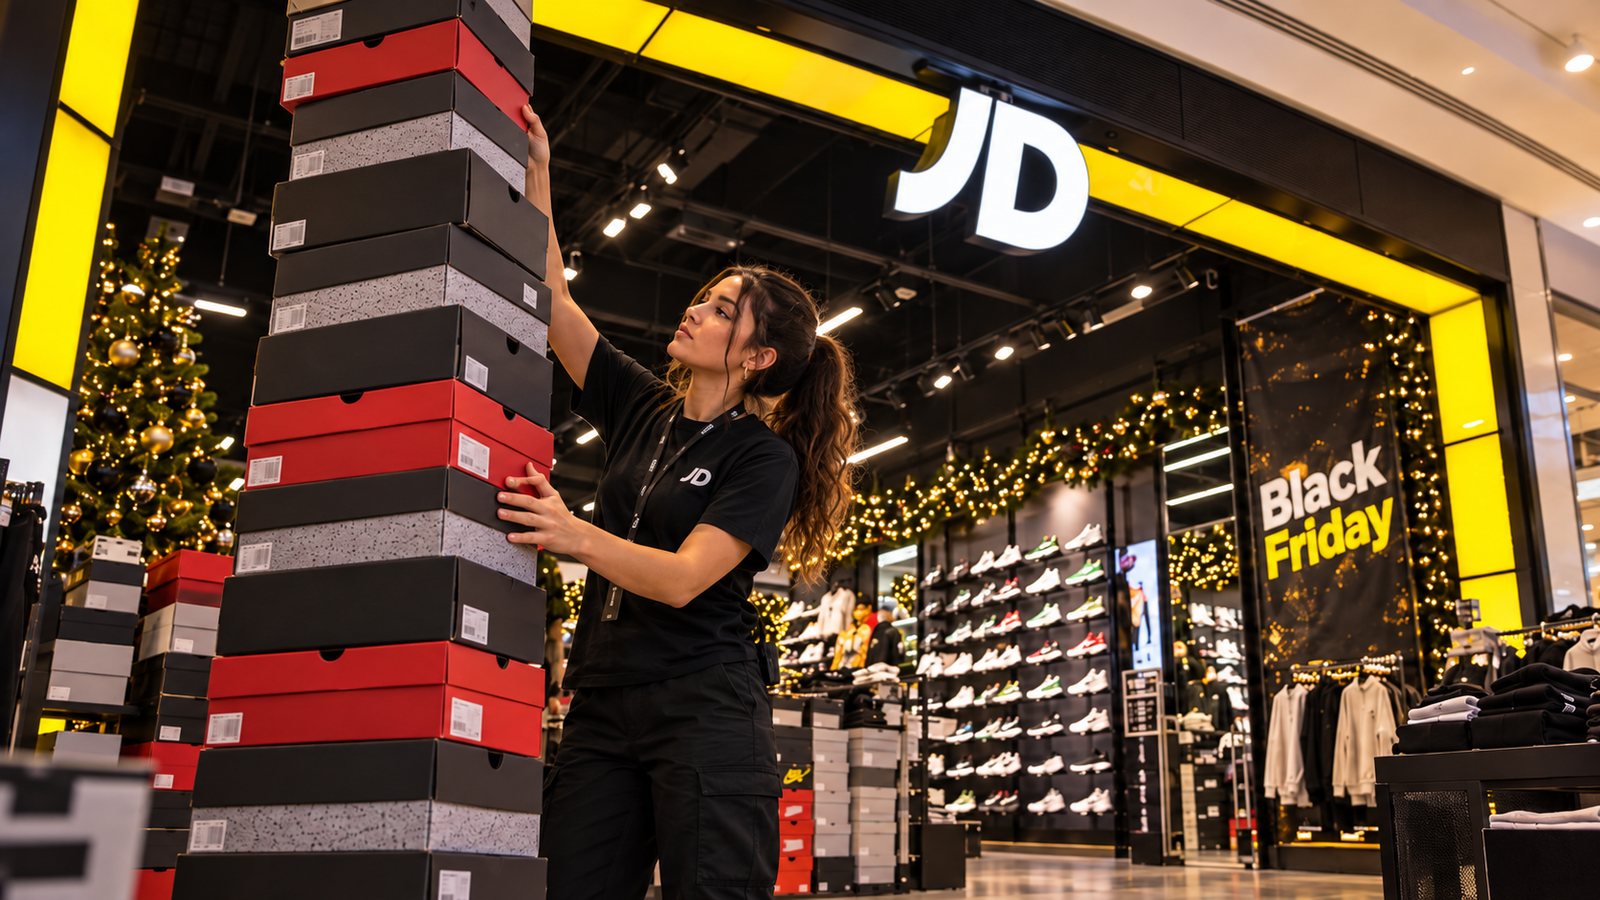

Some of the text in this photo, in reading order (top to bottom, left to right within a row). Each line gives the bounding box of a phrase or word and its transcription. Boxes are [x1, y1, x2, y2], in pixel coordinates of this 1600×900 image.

[893, 86, 1090, 250] JD
[679, 467, 712, 486] JD
[1260, 440, 1388, 531] Black
[1264, 497, 1394, 581] Friday
